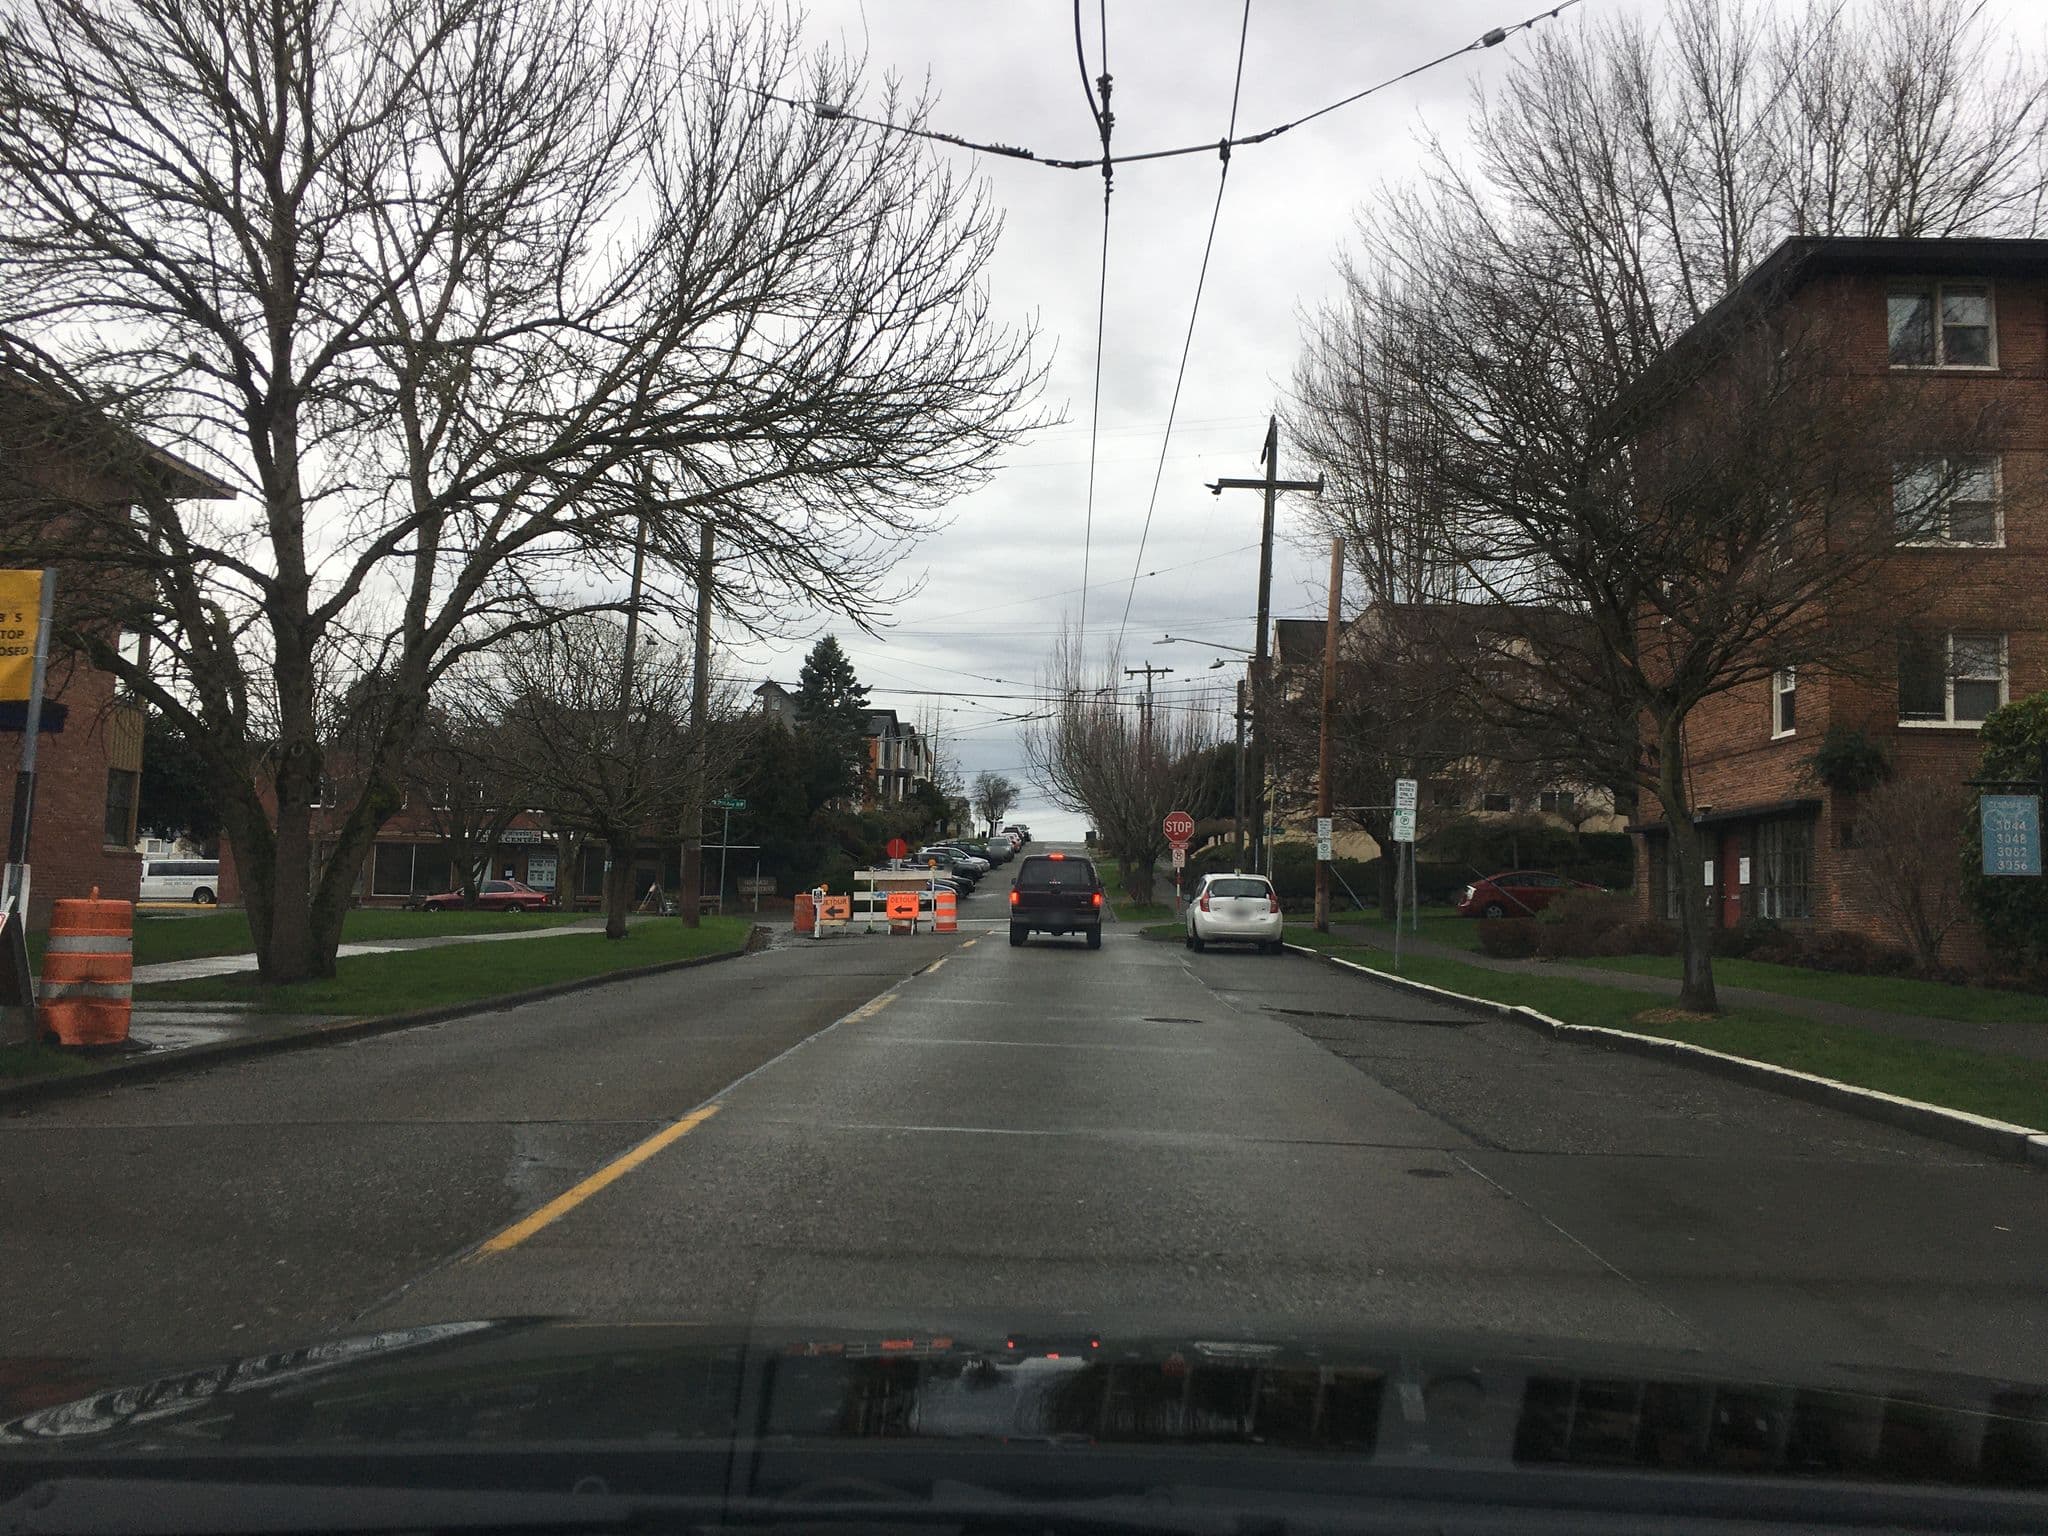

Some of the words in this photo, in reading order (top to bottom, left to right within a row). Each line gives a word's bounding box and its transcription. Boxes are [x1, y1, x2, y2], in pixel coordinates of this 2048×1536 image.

[1166, 821, 1191, 833] STOP
[1996, 833, 2027, 844] 3048
[890, 896, 917, 904] DETOUR
